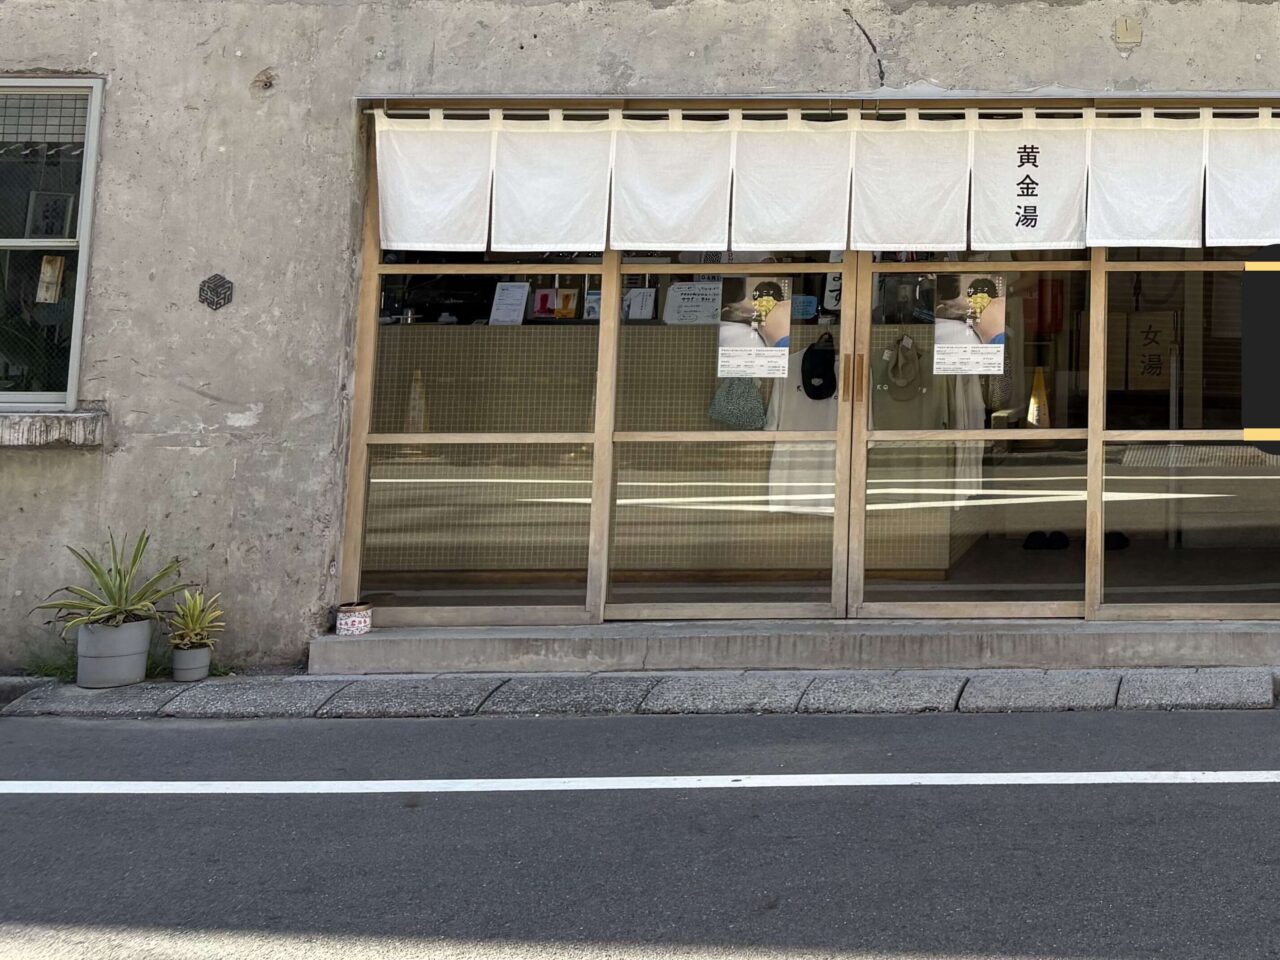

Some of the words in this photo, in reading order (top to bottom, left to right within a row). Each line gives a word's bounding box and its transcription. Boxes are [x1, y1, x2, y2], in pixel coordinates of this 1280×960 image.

[1015, 144, 1040, 228] 黄金湯
[1140, 324, 1162, 377] 女湯
